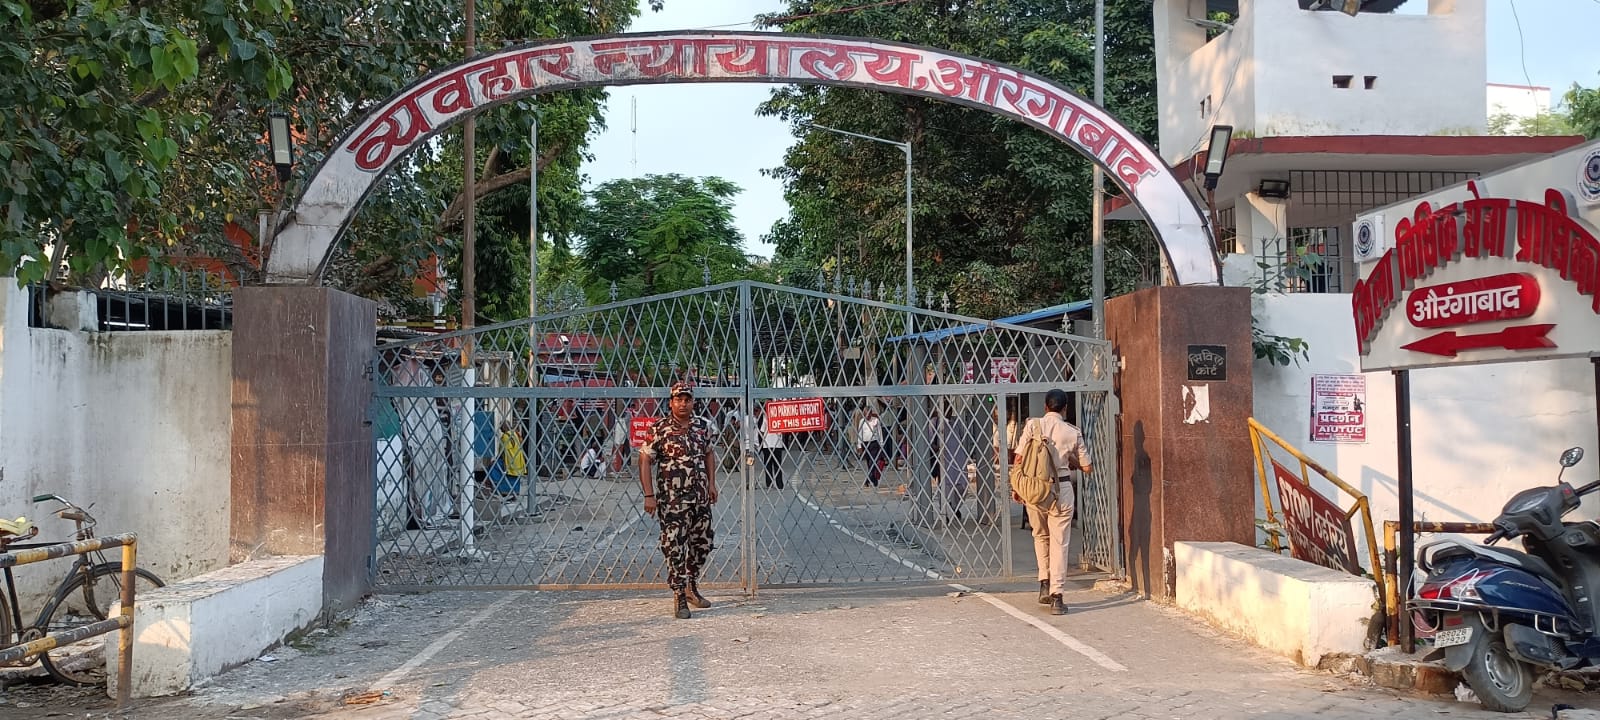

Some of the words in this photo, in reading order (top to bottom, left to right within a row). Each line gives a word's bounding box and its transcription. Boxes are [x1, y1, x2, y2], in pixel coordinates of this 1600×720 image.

[348, 45, 581, 170] व्यवहार
[1352, 248, 1394, 356] जिला
[1395, 201, 1458, 291] विधिक
[1463, 180, 1510, 258] सेवा
[1516, 188, 1600, 314] प्राधिका
[1412, 285, 1522, 322] औरंगाबाद
[1188, 349, 1224, 366] सिविल
[1195, 364, 1217, 375] कोर्ट
[770, 406, 778, 417] NO
[778, 404, 798, 417] PARKING
[799, 403, 819, 415] INFRONT
[772, 420, 782, 428] OF
[783, 419, 799, 428] THIS
[802, 417, 820, 426] GATE
[1319, 412, 1361, 423] प्रदर्शन
[1318, 426, 1362, 434] AIUTUC
